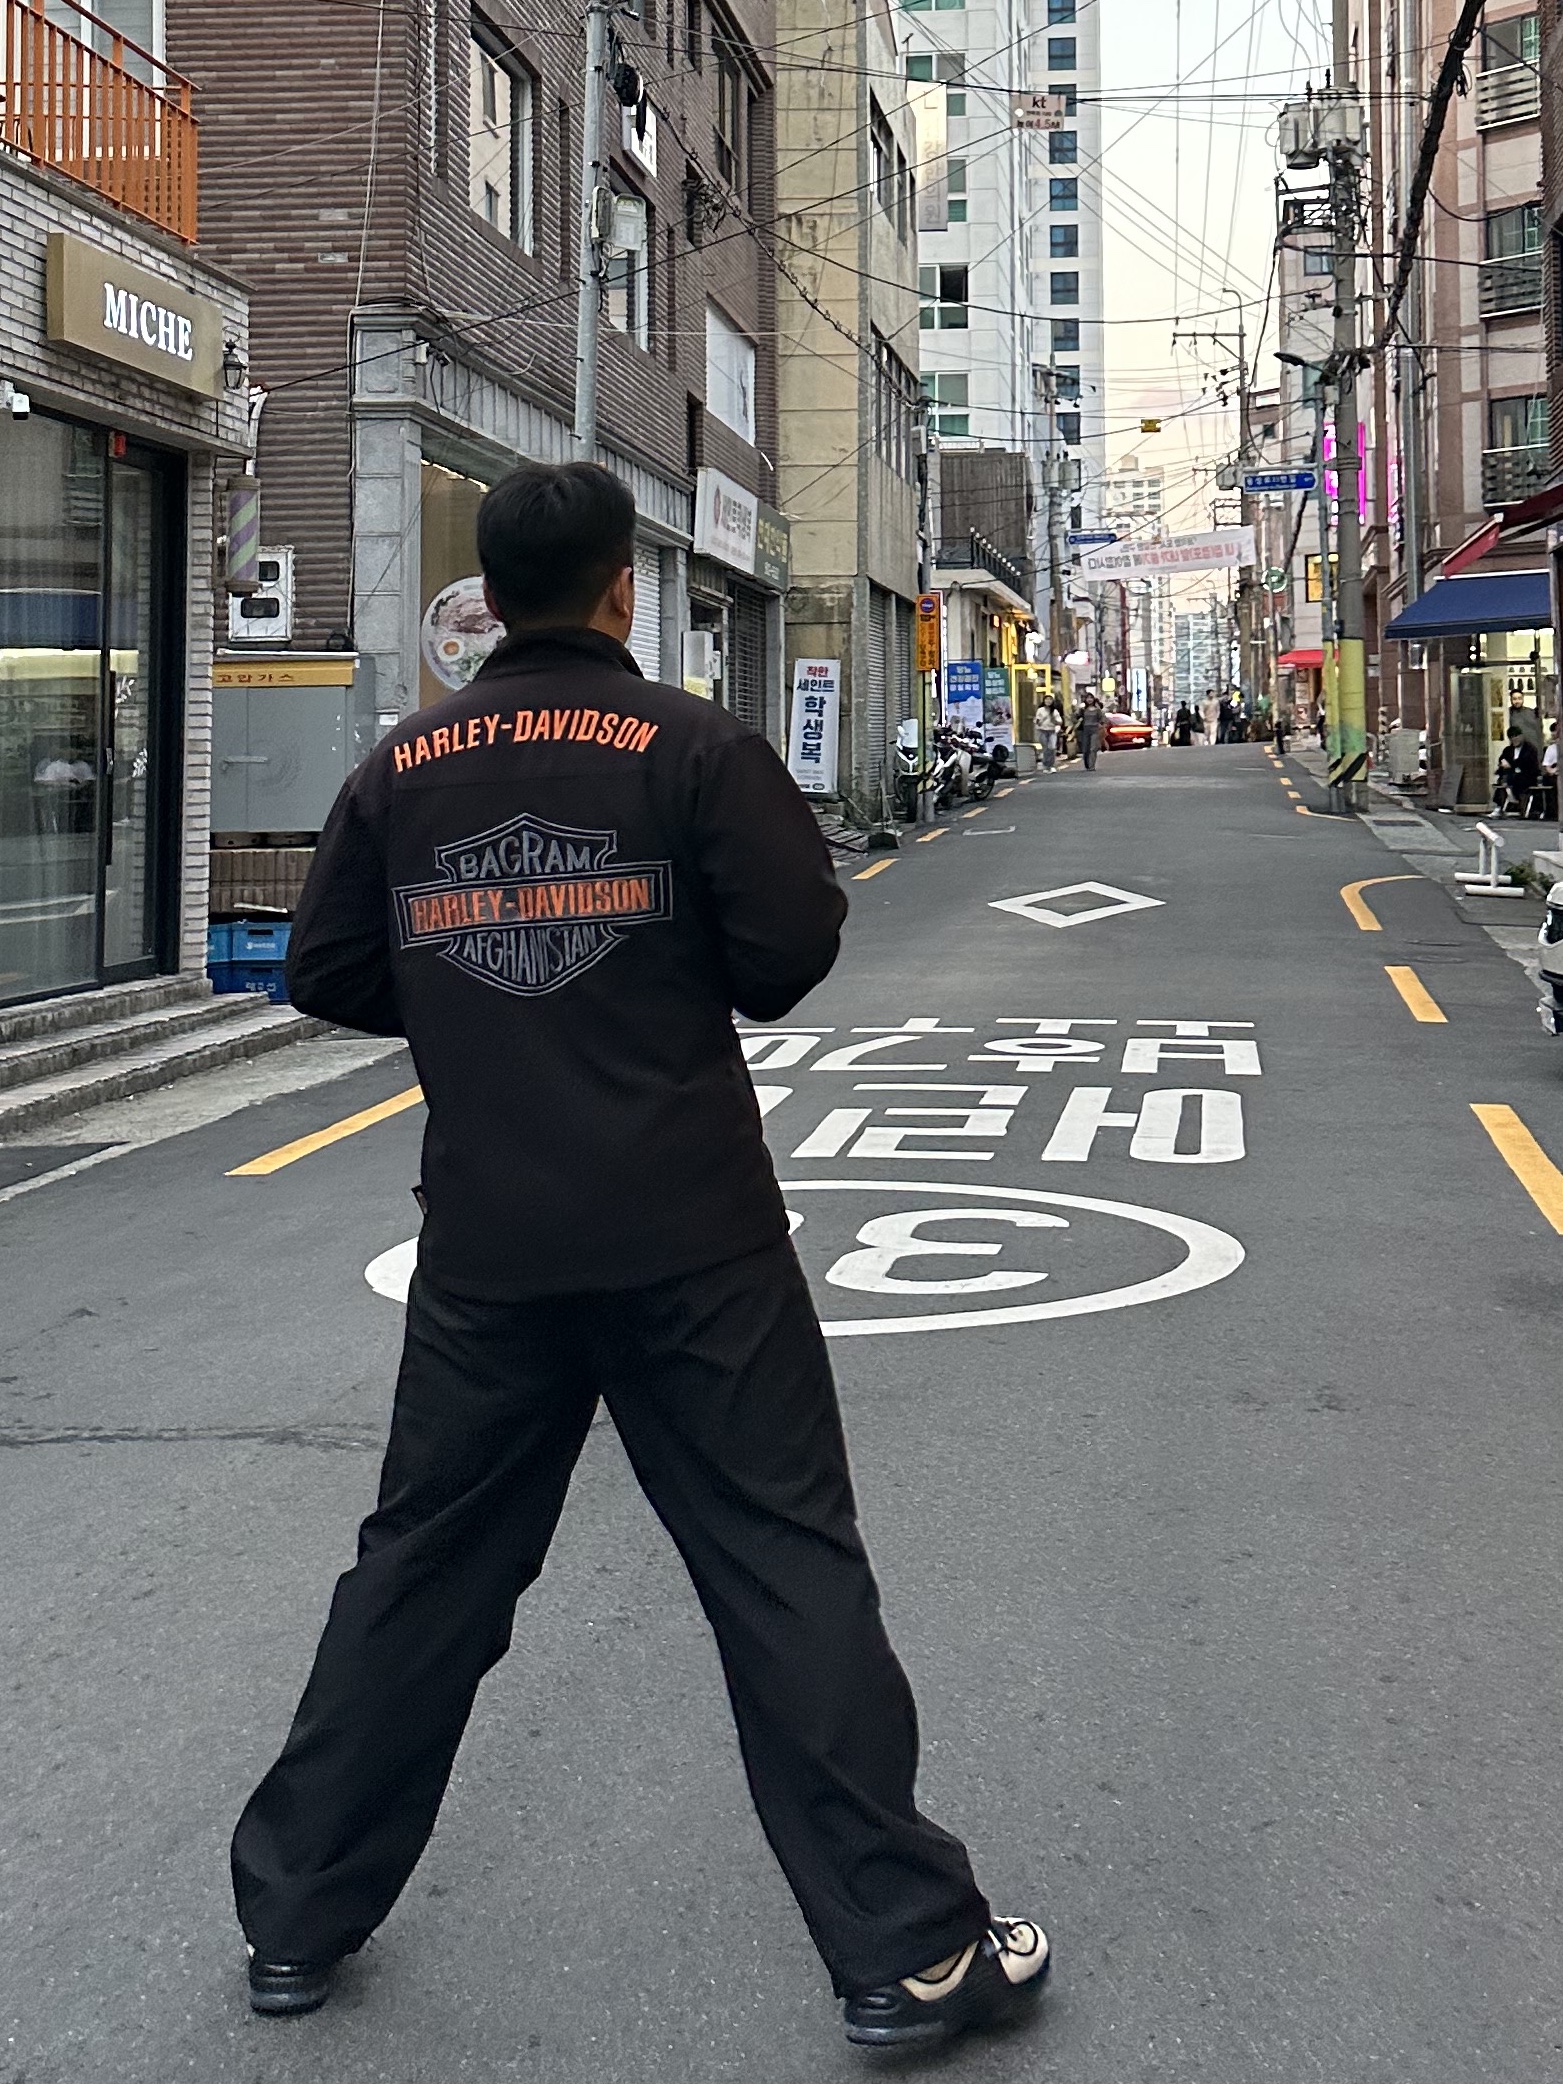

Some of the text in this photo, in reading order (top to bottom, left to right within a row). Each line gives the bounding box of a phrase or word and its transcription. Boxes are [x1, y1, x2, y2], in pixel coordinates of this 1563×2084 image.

[1031, 97, 1047, 108] kt
[103, 282, 193, 361] MICHE
[797, 678, 835, 693] 세인트
[806, 666, 829, 678] 착한
[393, 708, 659, 773] HARLEY-DAVIDSON
[800, 695, 827, 764] 학생복
[459, 830, 592, 879] BAGRAM
[409, 878, 651, 934] HARLEY-DAVIDSON
[461, 924, 599, 986] AFGHANISTAN
